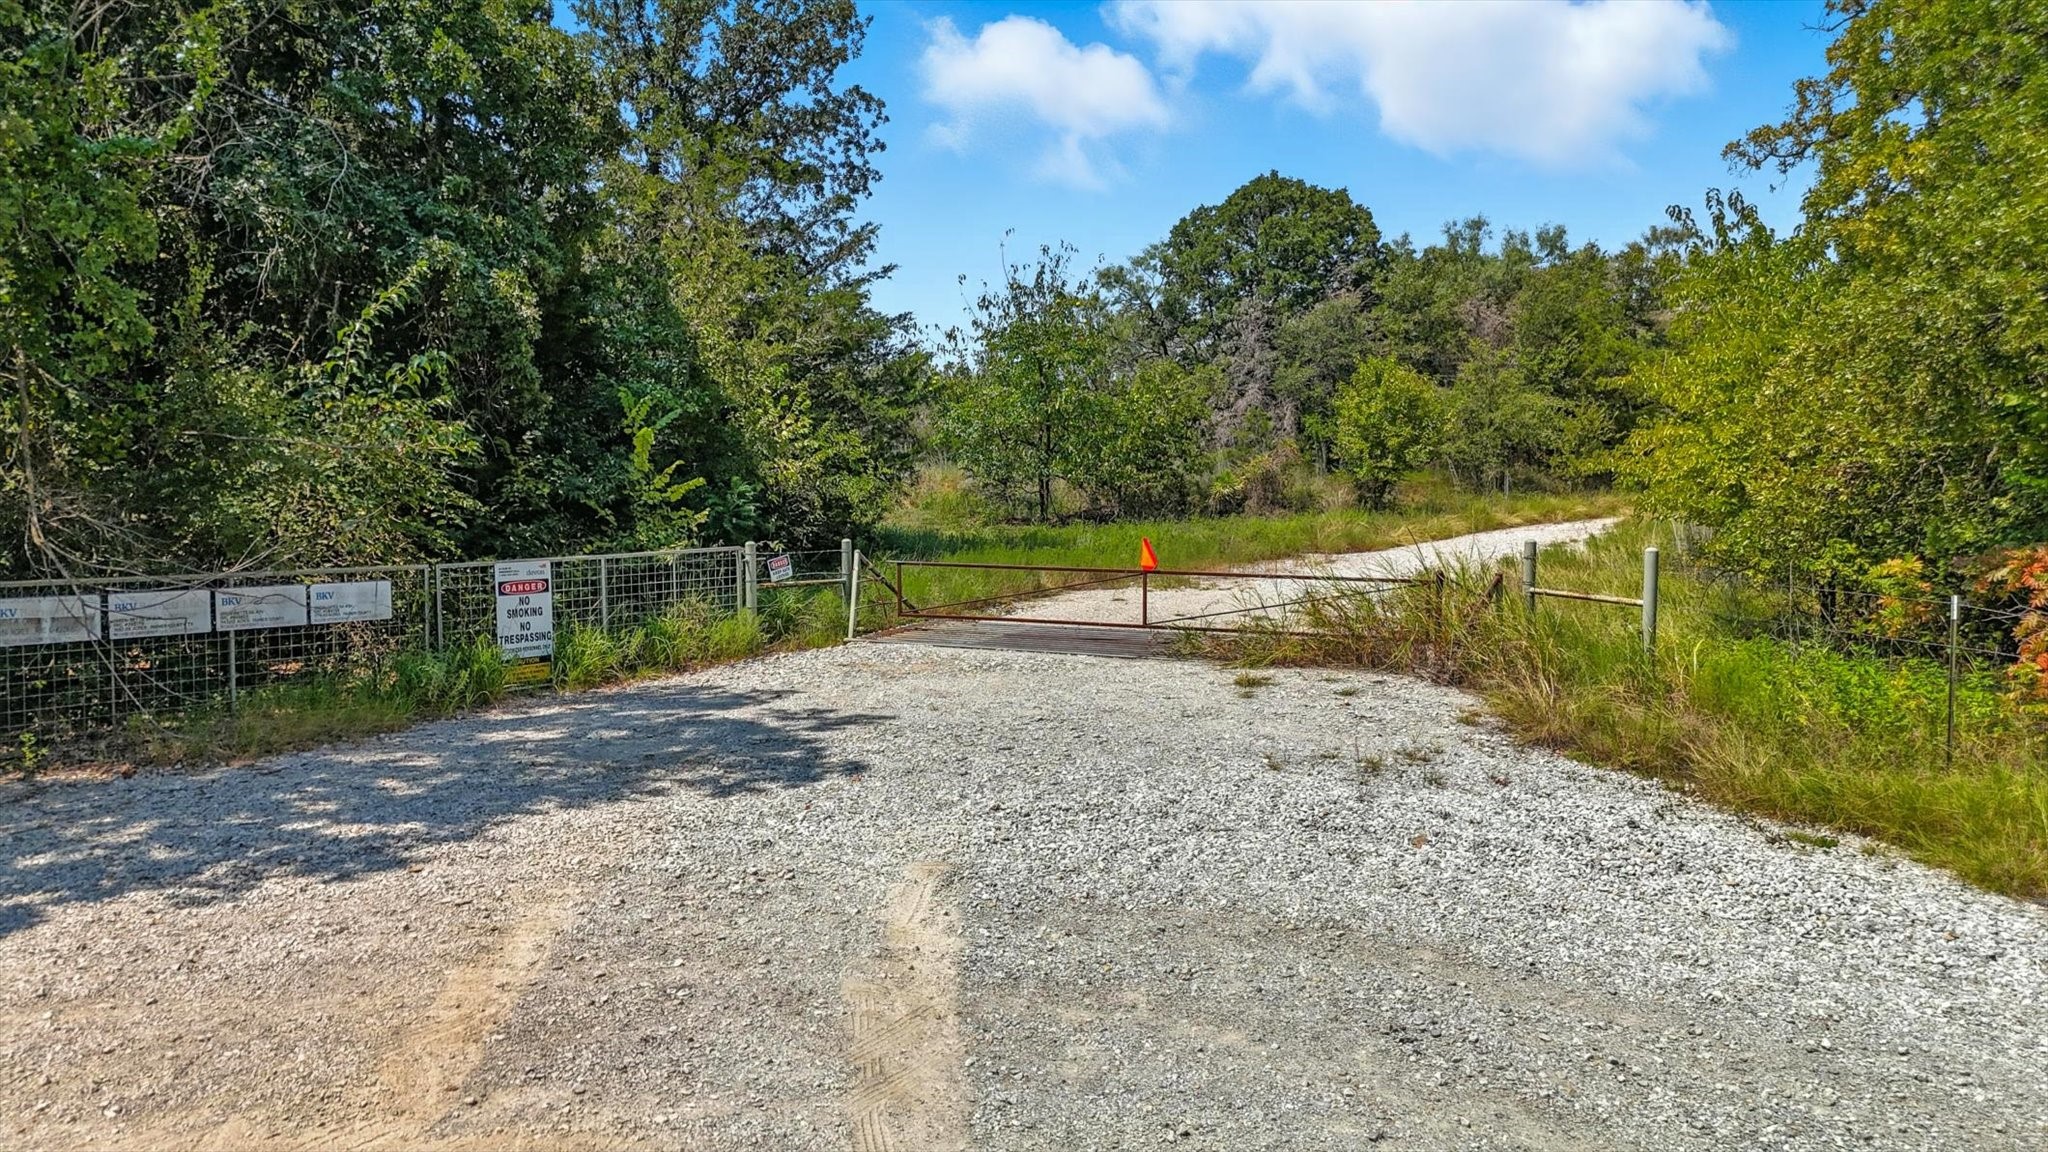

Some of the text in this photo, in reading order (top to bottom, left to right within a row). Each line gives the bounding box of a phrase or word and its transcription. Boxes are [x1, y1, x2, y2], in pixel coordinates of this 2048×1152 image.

[505, 582, 543, 592] DANGER
[316, 592, 335, 601] BKV
[519, 596, 530, 606] NO
[221, 597, 242, 606] BKV
[114, 602, 137, 612] BKV
[0, 608, 17, 617] KV
[507, 608, 543, 619] SMOKING
[520, 622, 531, 631] NO
[499, 631, 552, 646] TRESPASSING
[516, 657, 540, 665] AUTION
